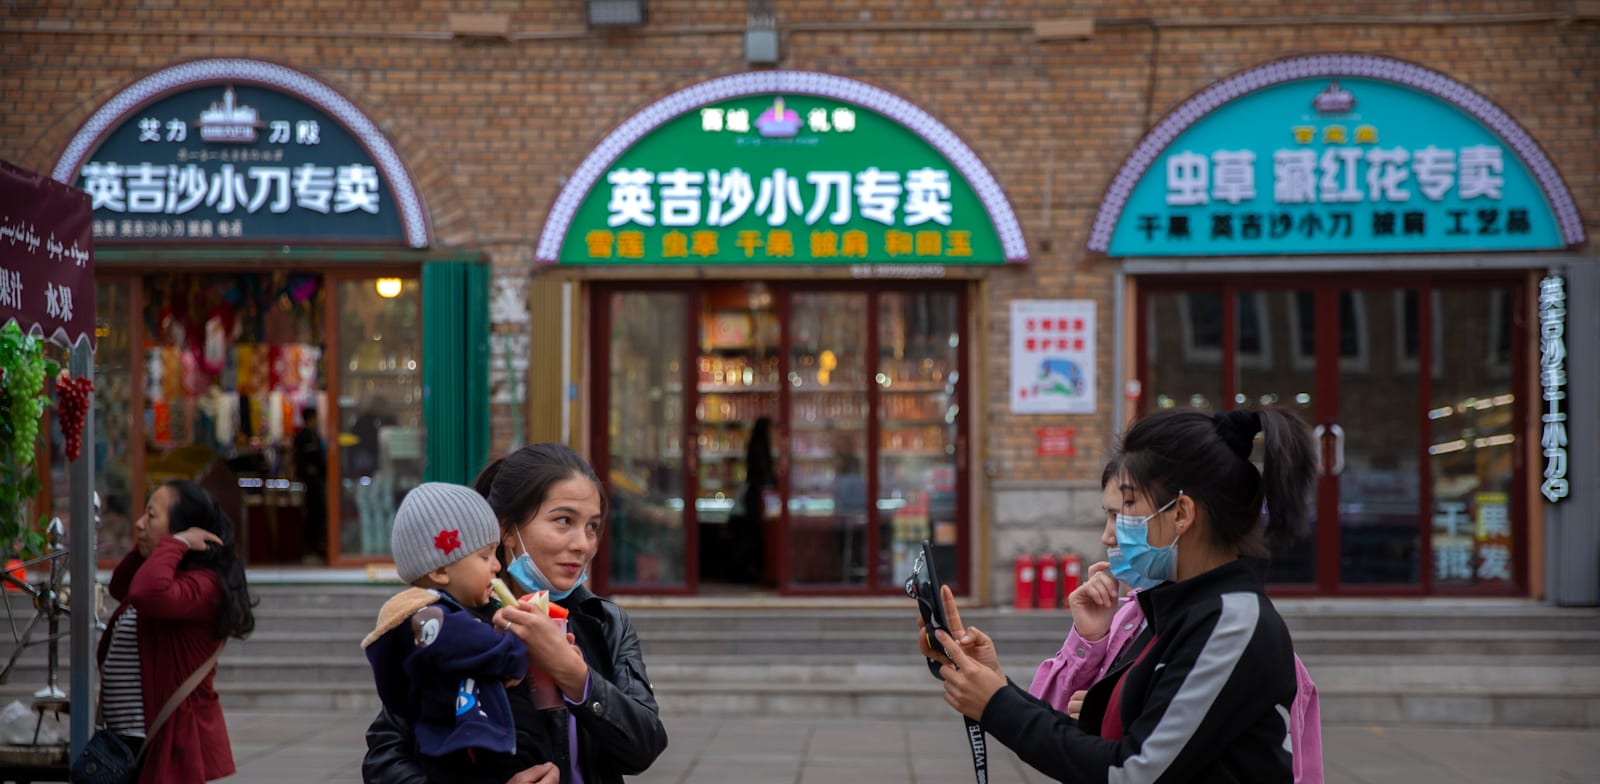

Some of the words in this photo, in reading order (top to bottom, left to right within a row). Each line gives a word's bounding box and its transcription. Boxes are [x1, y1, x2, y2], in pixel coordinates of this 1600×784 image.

[137, 117, 187, 142] 艾力
[81, 162, 380, 214] 英吉沙小刀专卖
[1165, 151, 1257, 206] 虫草
[1273, 144, 1505, 203] 藏红花专卖
[606, 166, 953, 227] 英吉沙小刀专卖
[586, 230, 645, 258] 雪莲
[661, 230, 719, 258] 虫草
[736, 230, 794, 258] 干果
[884, 230, 973, 258] 和田玉
[1136, 213, 1191, 242] 干果
[1209, 210, 1354, 241] 英吉沙小刀
[1446, 207, 1532, 236] 工艺品
[44, 281, 73, 322] 水果
[968, 724, 985, 768] WHITE
